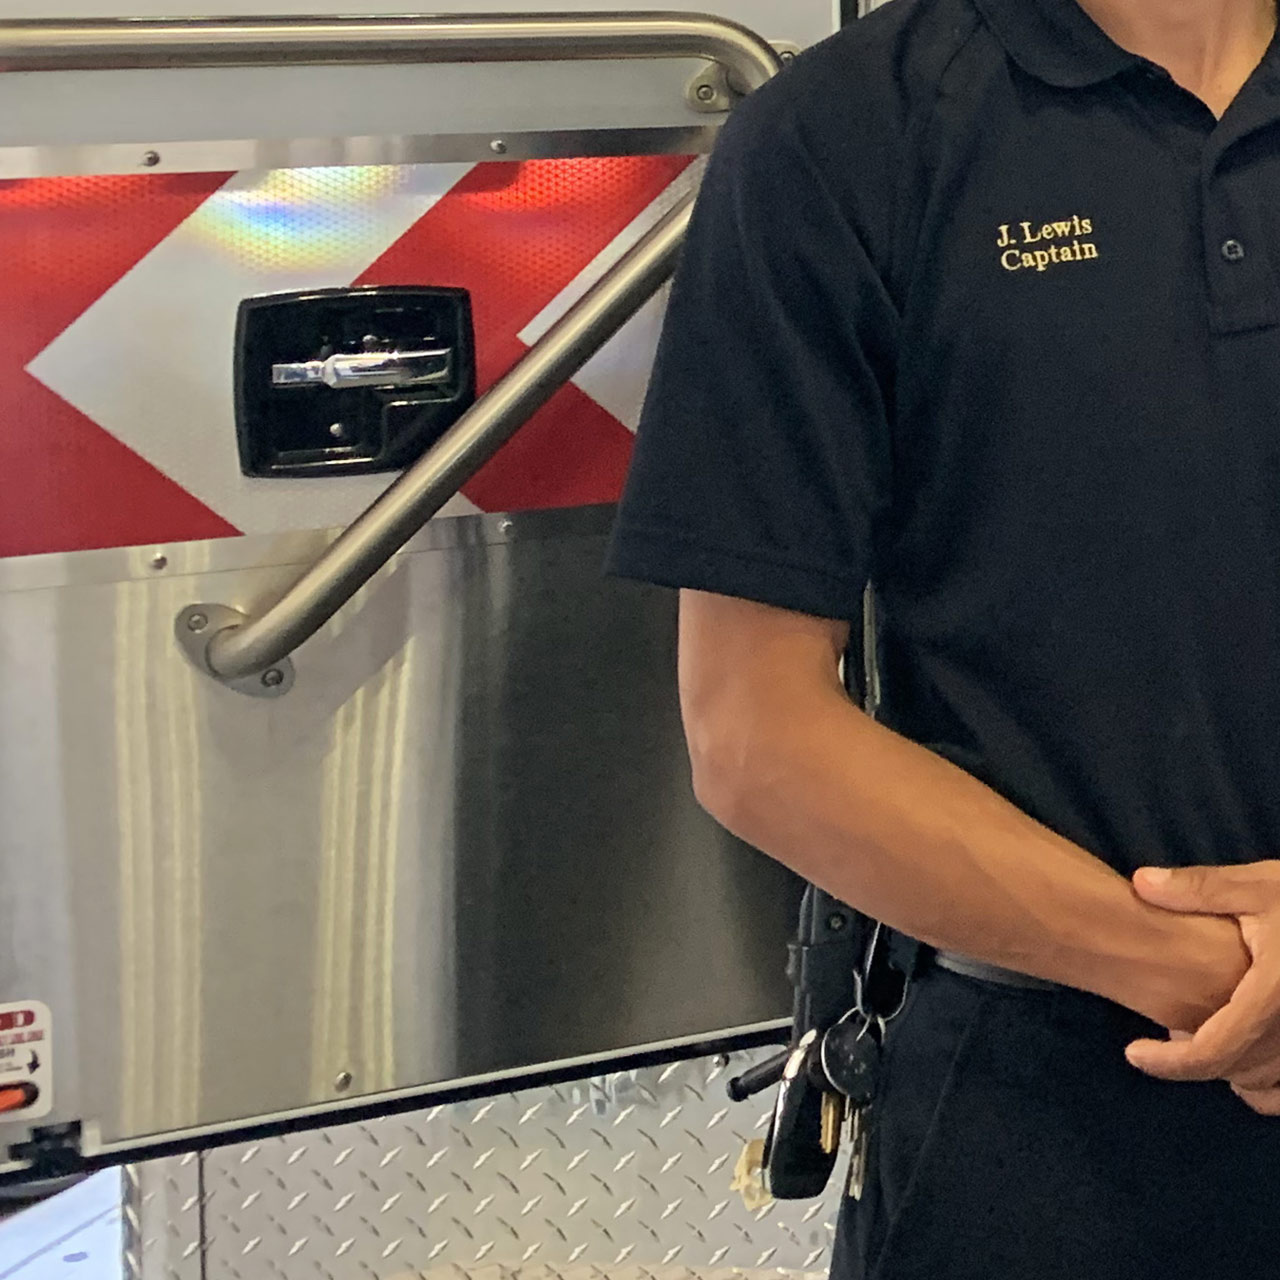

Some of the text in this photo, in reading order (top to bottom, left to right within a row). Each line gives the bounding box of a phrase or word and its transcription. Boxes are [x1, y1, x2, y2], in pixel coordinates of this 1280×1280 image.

[997, 214, 1093, 248] J. Lewis
[1001, 240, 1099, 272] Captain
